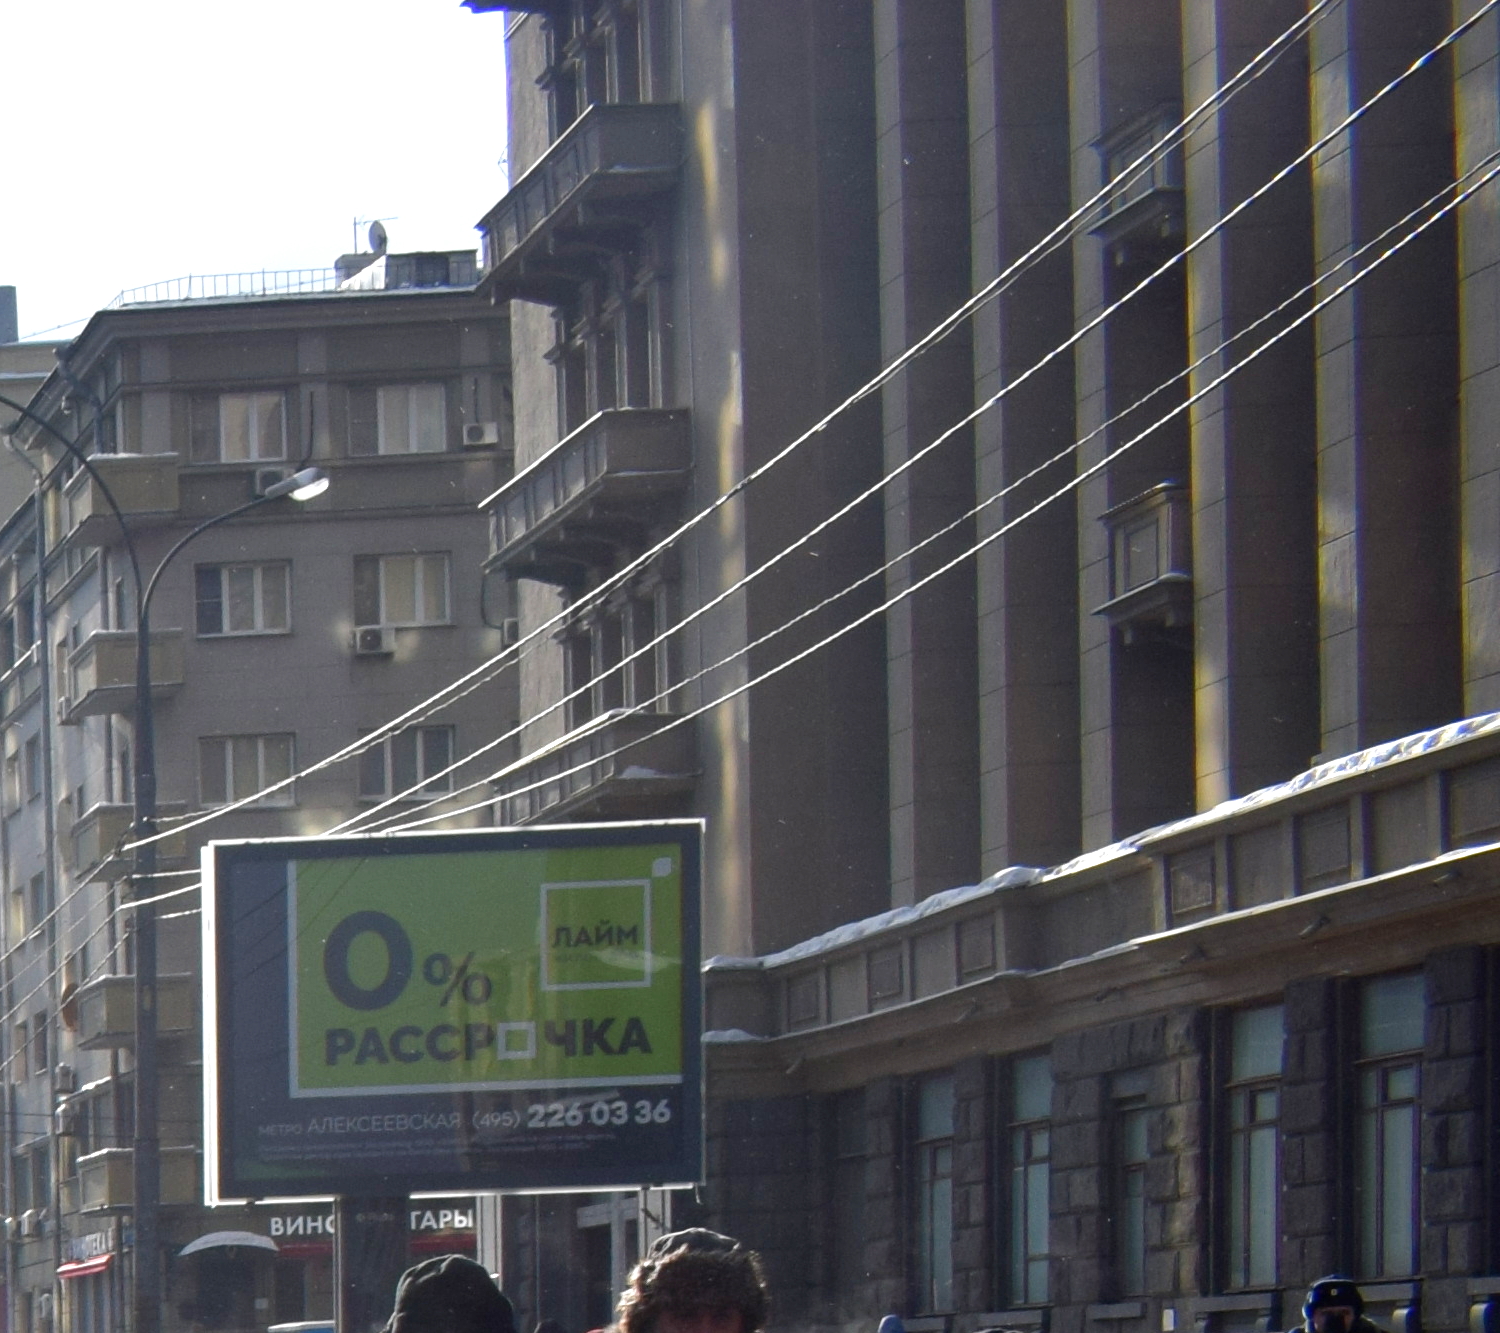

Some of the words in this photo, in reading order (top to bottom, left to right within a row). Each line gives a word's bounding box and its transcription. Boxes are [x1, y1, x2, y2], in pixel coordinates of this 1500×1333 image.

[552, 919, 638, 948] ЛАЙМ
[258, 1123, 302, 1136] МЕТРО
[308, 1112, 461, 1133] АЛЕКСЕЕВСКАЯ
[472, 1110, 521, 1128] (495)
[527, 1102, 583, 1128] 226
[589, 1101, 628, 1126] 03
[634, 1098, 672, 1124] 36
